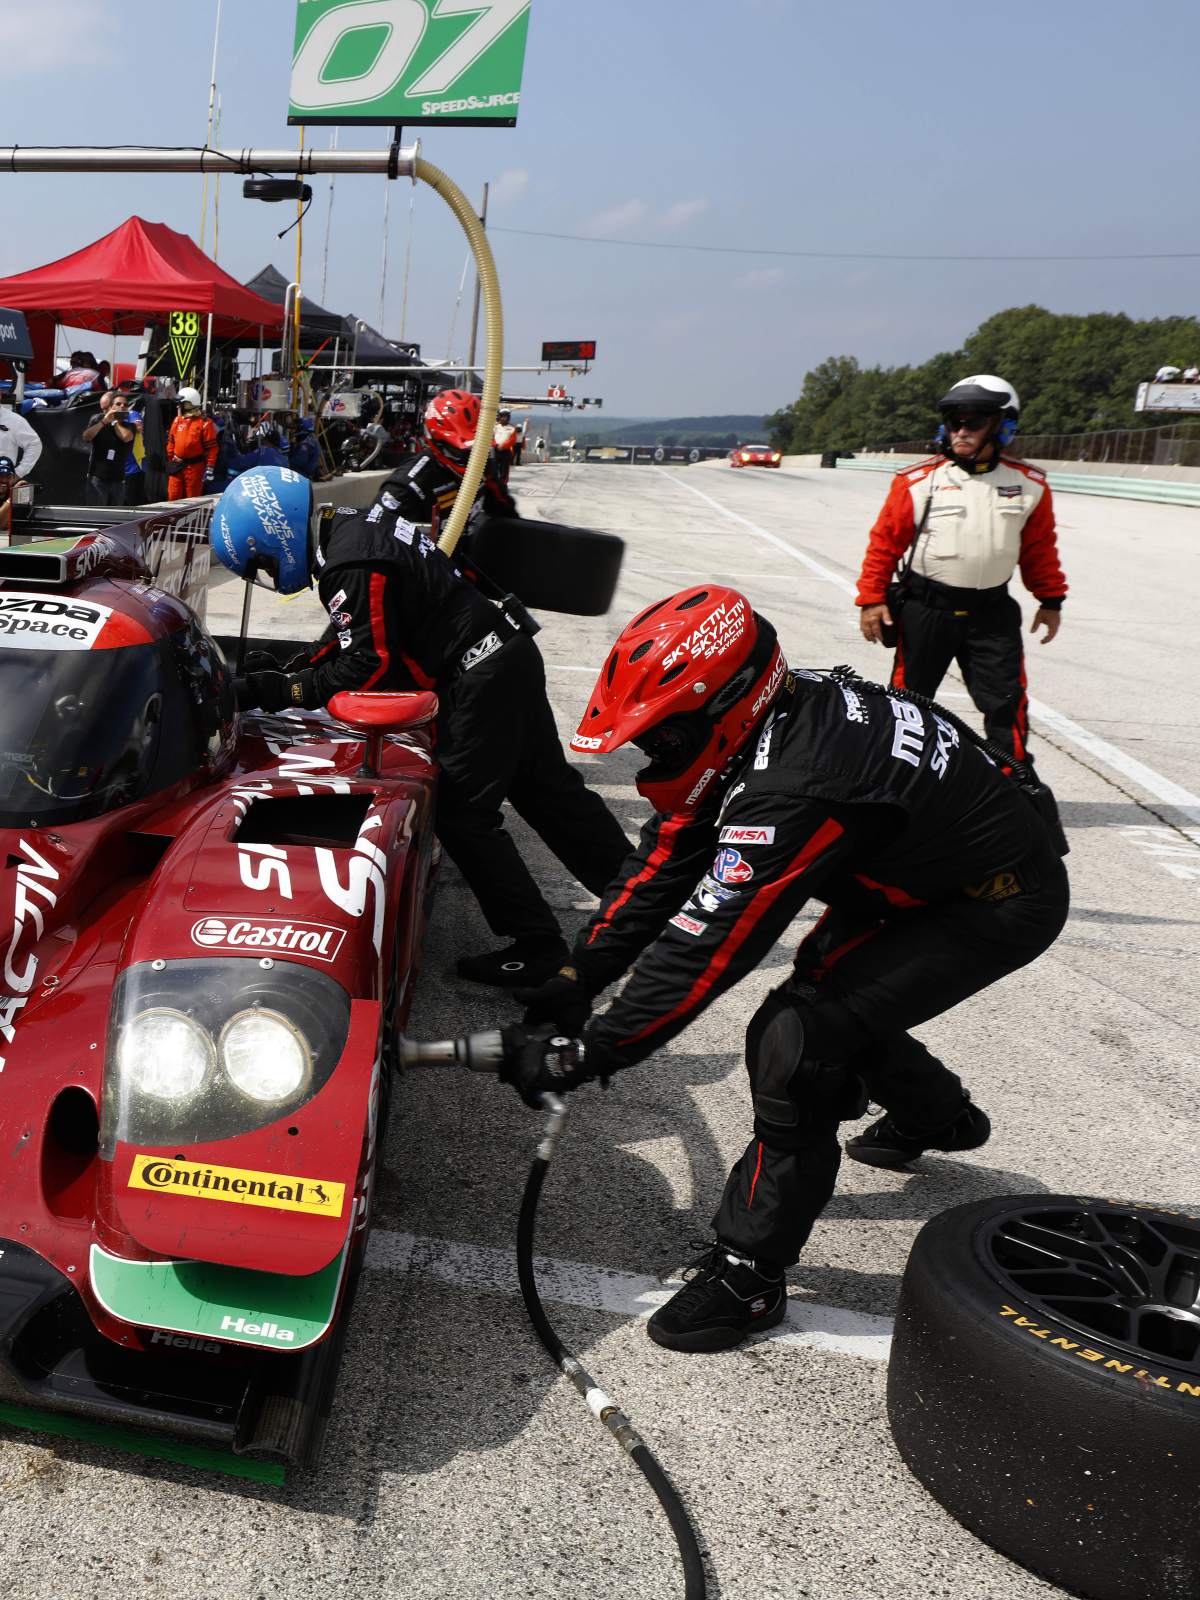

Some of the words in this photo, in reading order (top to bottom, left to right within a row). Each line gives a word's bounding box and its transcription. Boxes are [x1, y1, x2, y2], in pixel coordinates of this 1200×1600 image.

[290, 0, 531, 110] 07
[171, 311, 198, 335] 38
[661, 603, 727, 671] SKYACTIV
[690, 599, 746, 659] SKYACTIV
[704, 614, 746, 659] SKYACTIV
[717, 627, 745, 656] SKYACTIV
[685, 768, 716, 805] mazda
[728, 830, 768, 841] IMSA
[226, 921, 334, 955] Castrol
[141, 1161, 304, 1203] Continental
[221, 1314, 295, 1341] Hella
